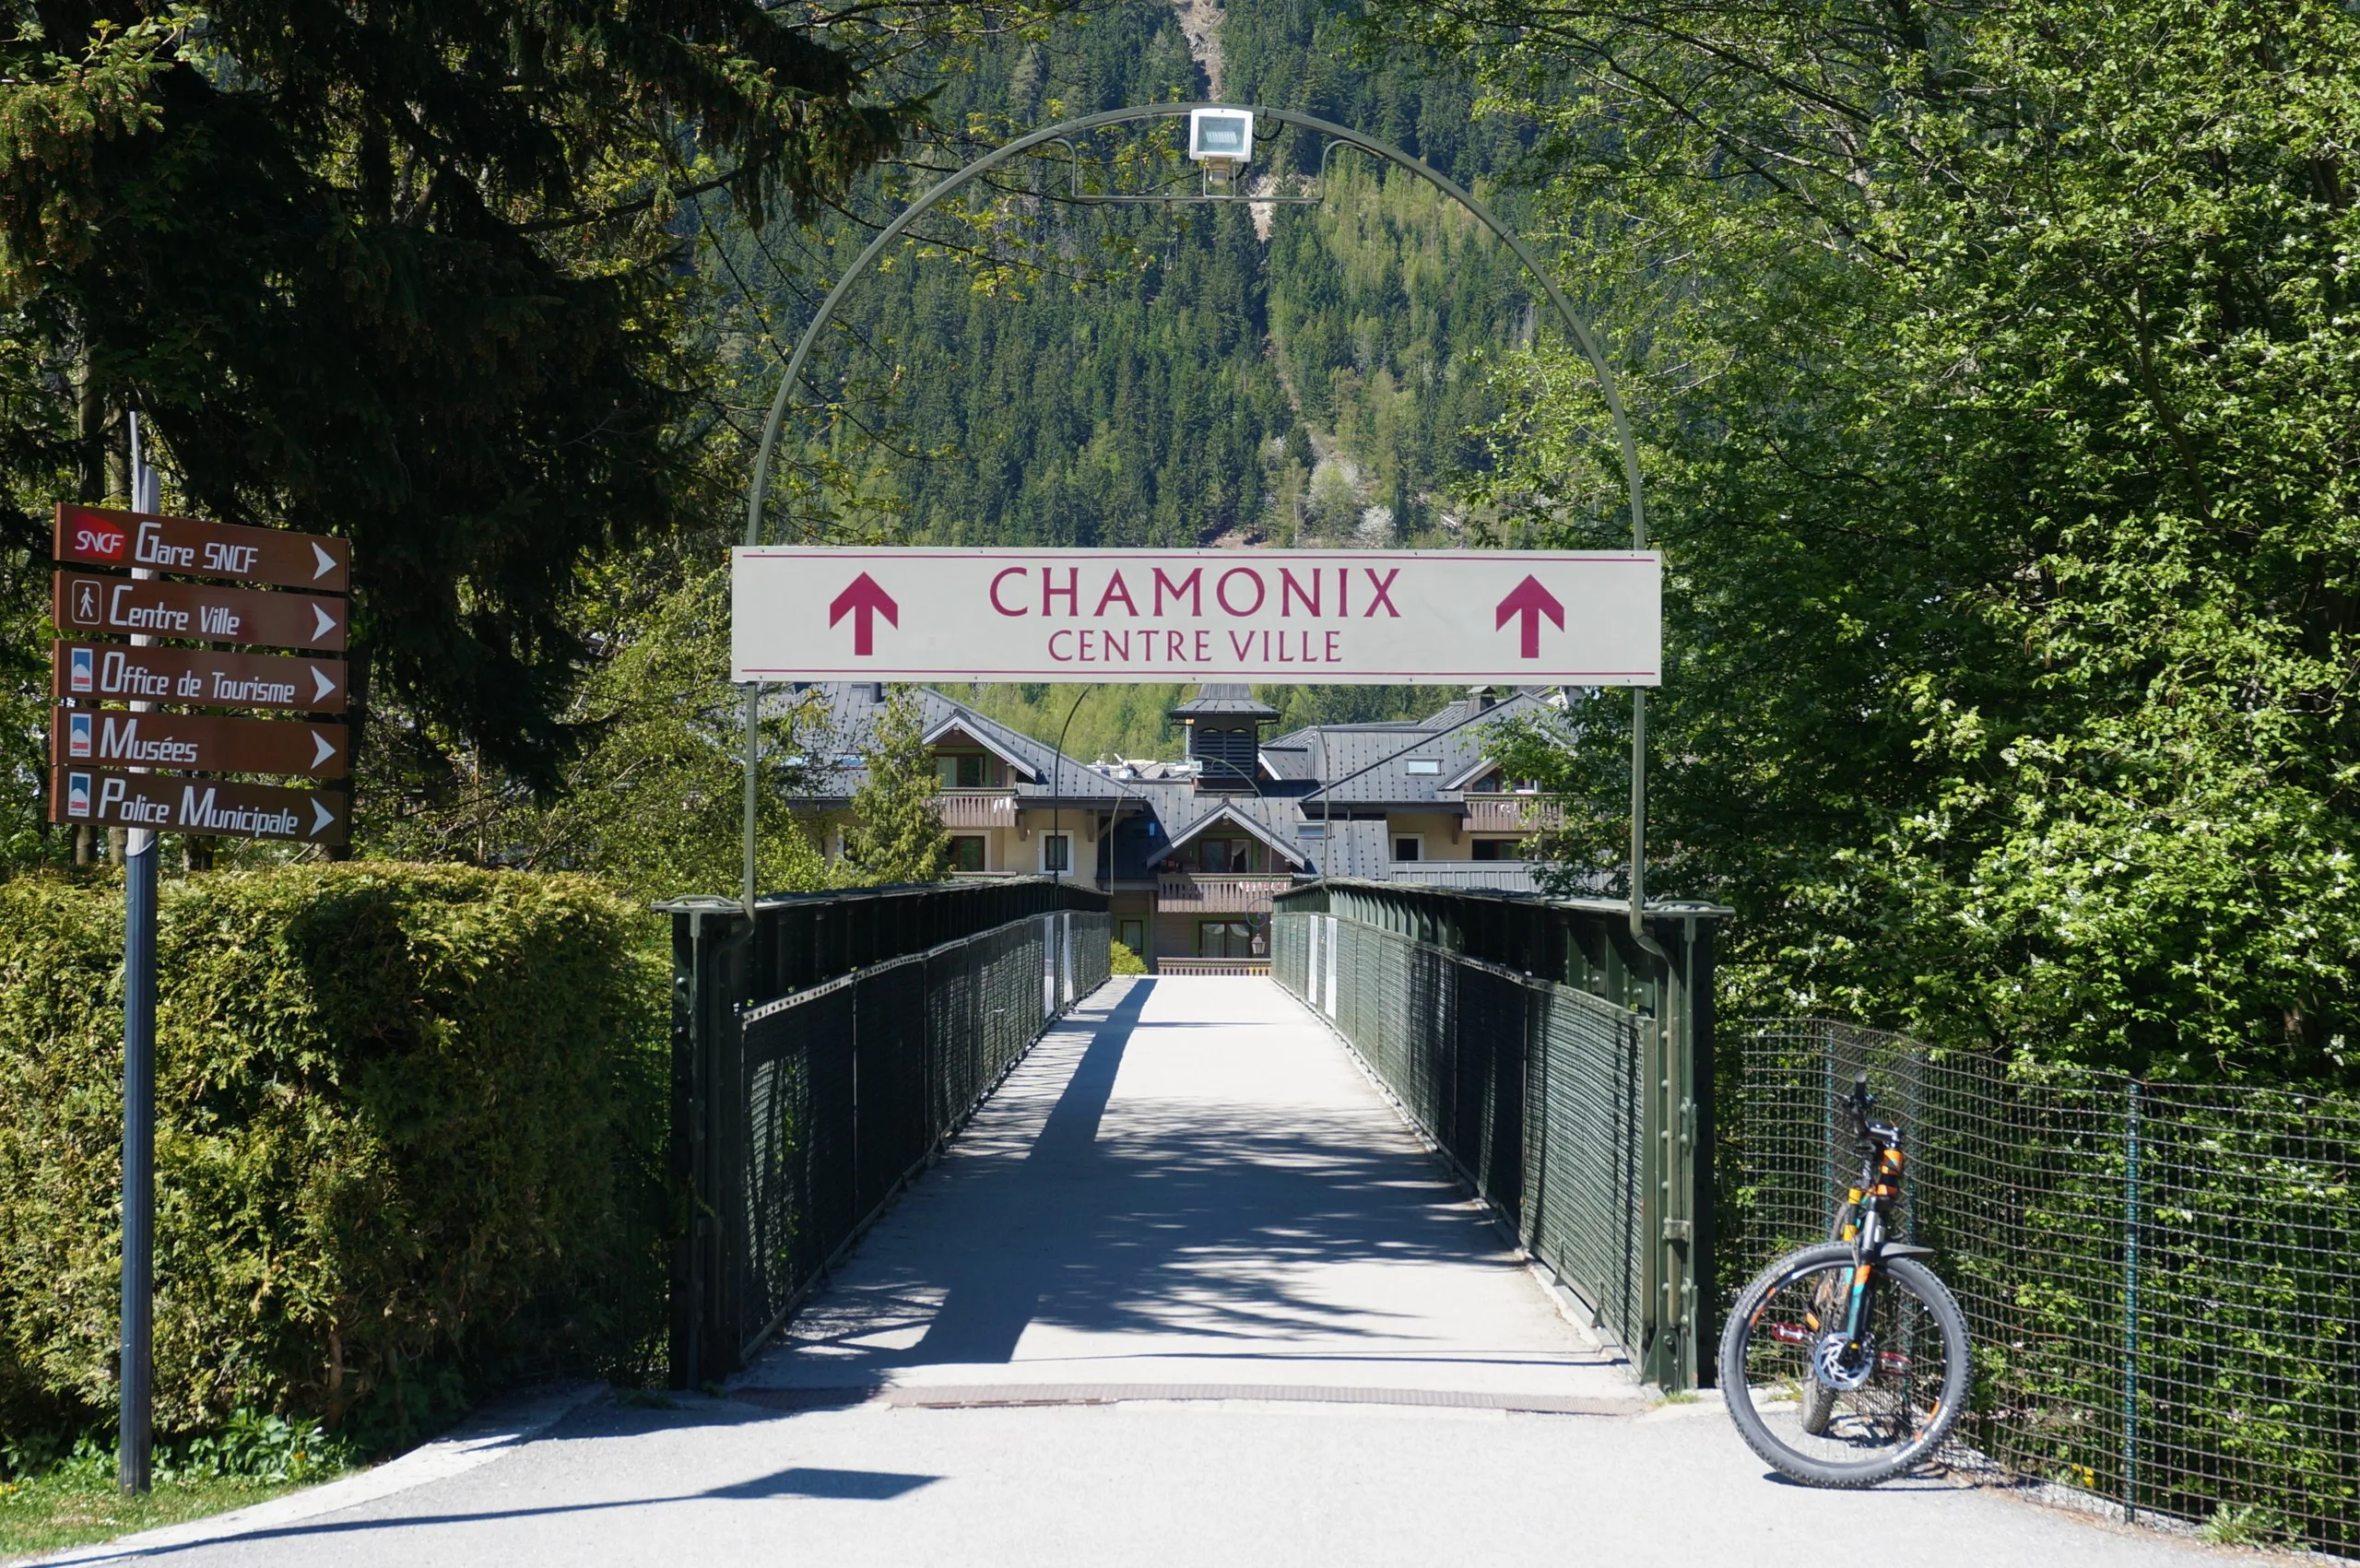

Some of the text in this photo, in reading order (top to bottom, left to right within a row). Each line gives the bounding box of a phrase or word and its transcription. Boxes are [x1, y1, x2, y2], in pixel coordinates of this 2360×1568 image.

[75, 530, 124, 554] SNCF
[135, 522, 259, 573] Gare SNCF
[109, 584, 241, 636] Centre Ville
[989, 566, 1402, 619] CHAMONIX
[1047, 630, 1343, 663] CENTRE VILLE
[100, 651, 169, 695] Office
[176, 670, 202, 698] de
[211, 671, 296, 703] Tourisme
[99, 717, 199, 763] Musées
[97, 777, 300, 838] Police Municipale
